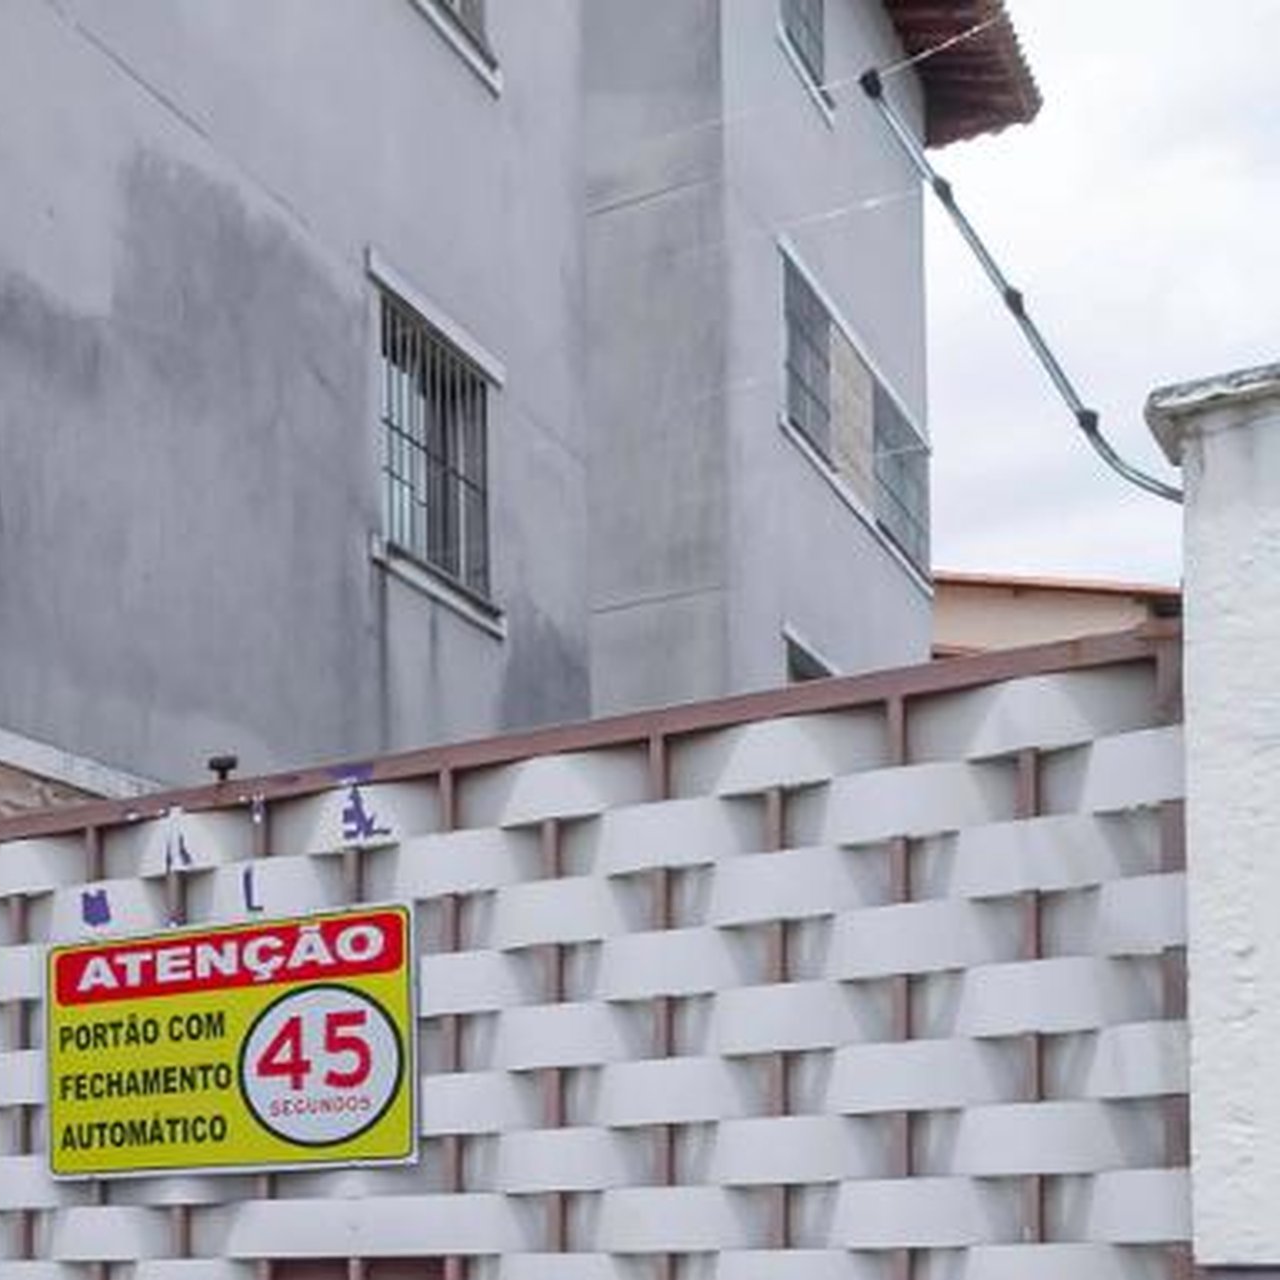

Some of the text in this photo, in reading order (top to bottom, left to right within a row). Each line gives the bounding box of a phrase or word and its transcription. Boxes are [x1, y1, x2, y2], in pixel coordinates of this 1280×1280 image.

[76, 921, 386, 992] ATENÇÃO
[58, 1010, 226, 1053] PORTÃO COM
[255, 1008, 372, 1091] 45
[58, 1062, 233, 1101] FECHAMENTO
[269, 1095, 372, 1118] SEGUNDOS
[60, 1111, 228, 1151] AUTOMÁTICO
